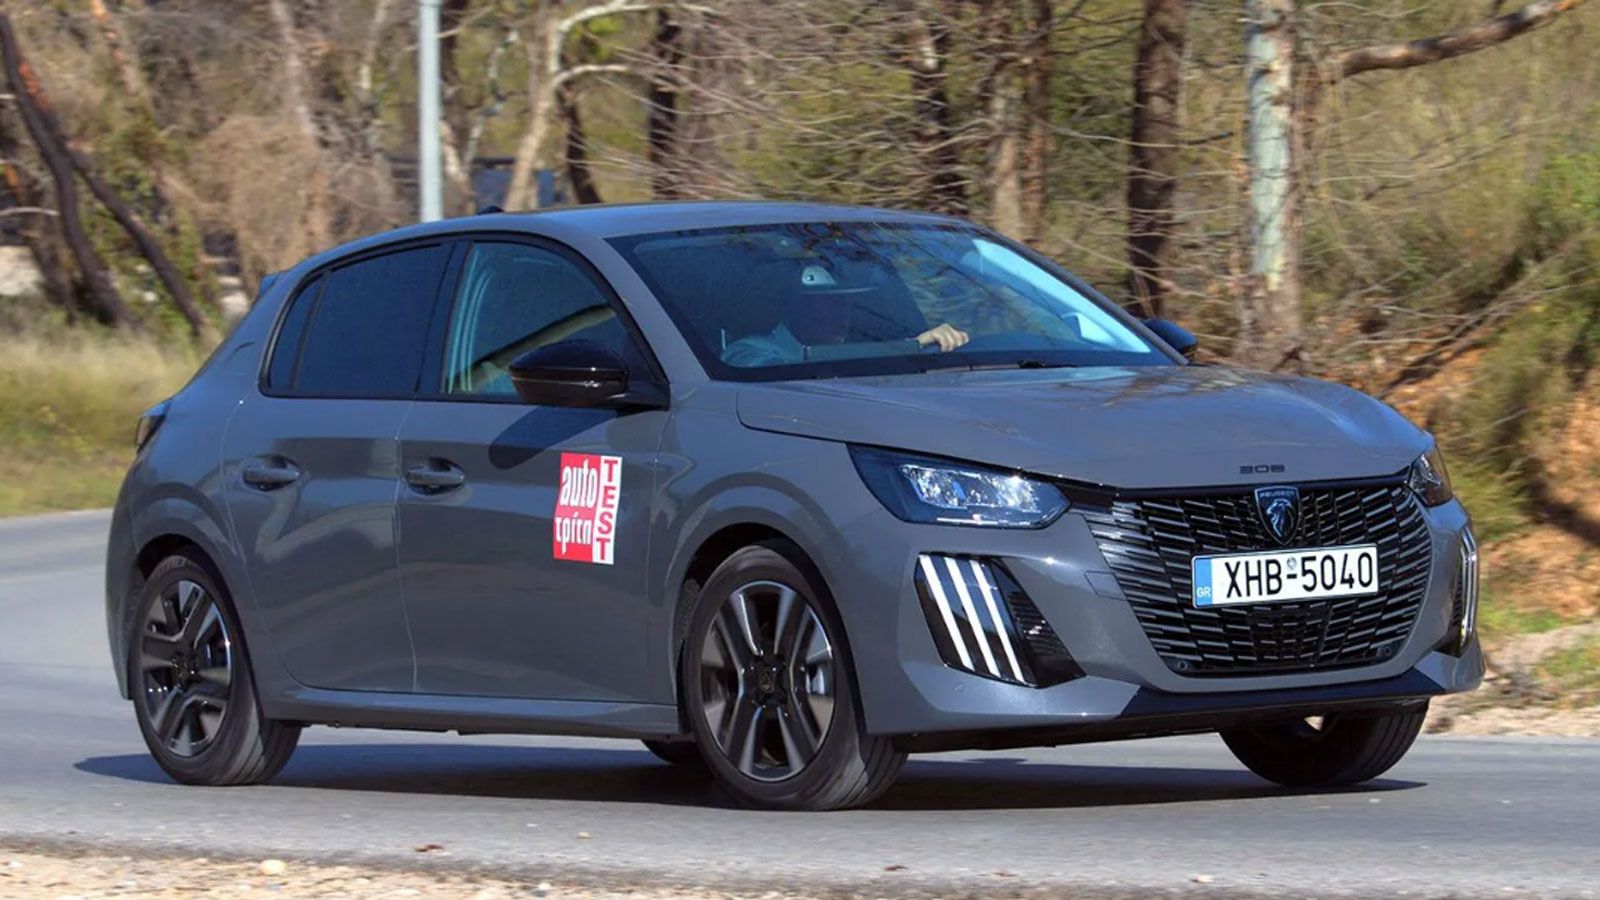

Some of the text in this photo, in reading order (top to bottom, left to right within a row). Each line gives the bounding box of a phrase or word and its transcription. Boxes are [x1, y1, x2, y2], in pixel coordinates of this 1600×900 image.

[560, 458, 598, 508] auto
[596, 459, 618, 561] TEST
[1197, 587, 1211, 597] GR
